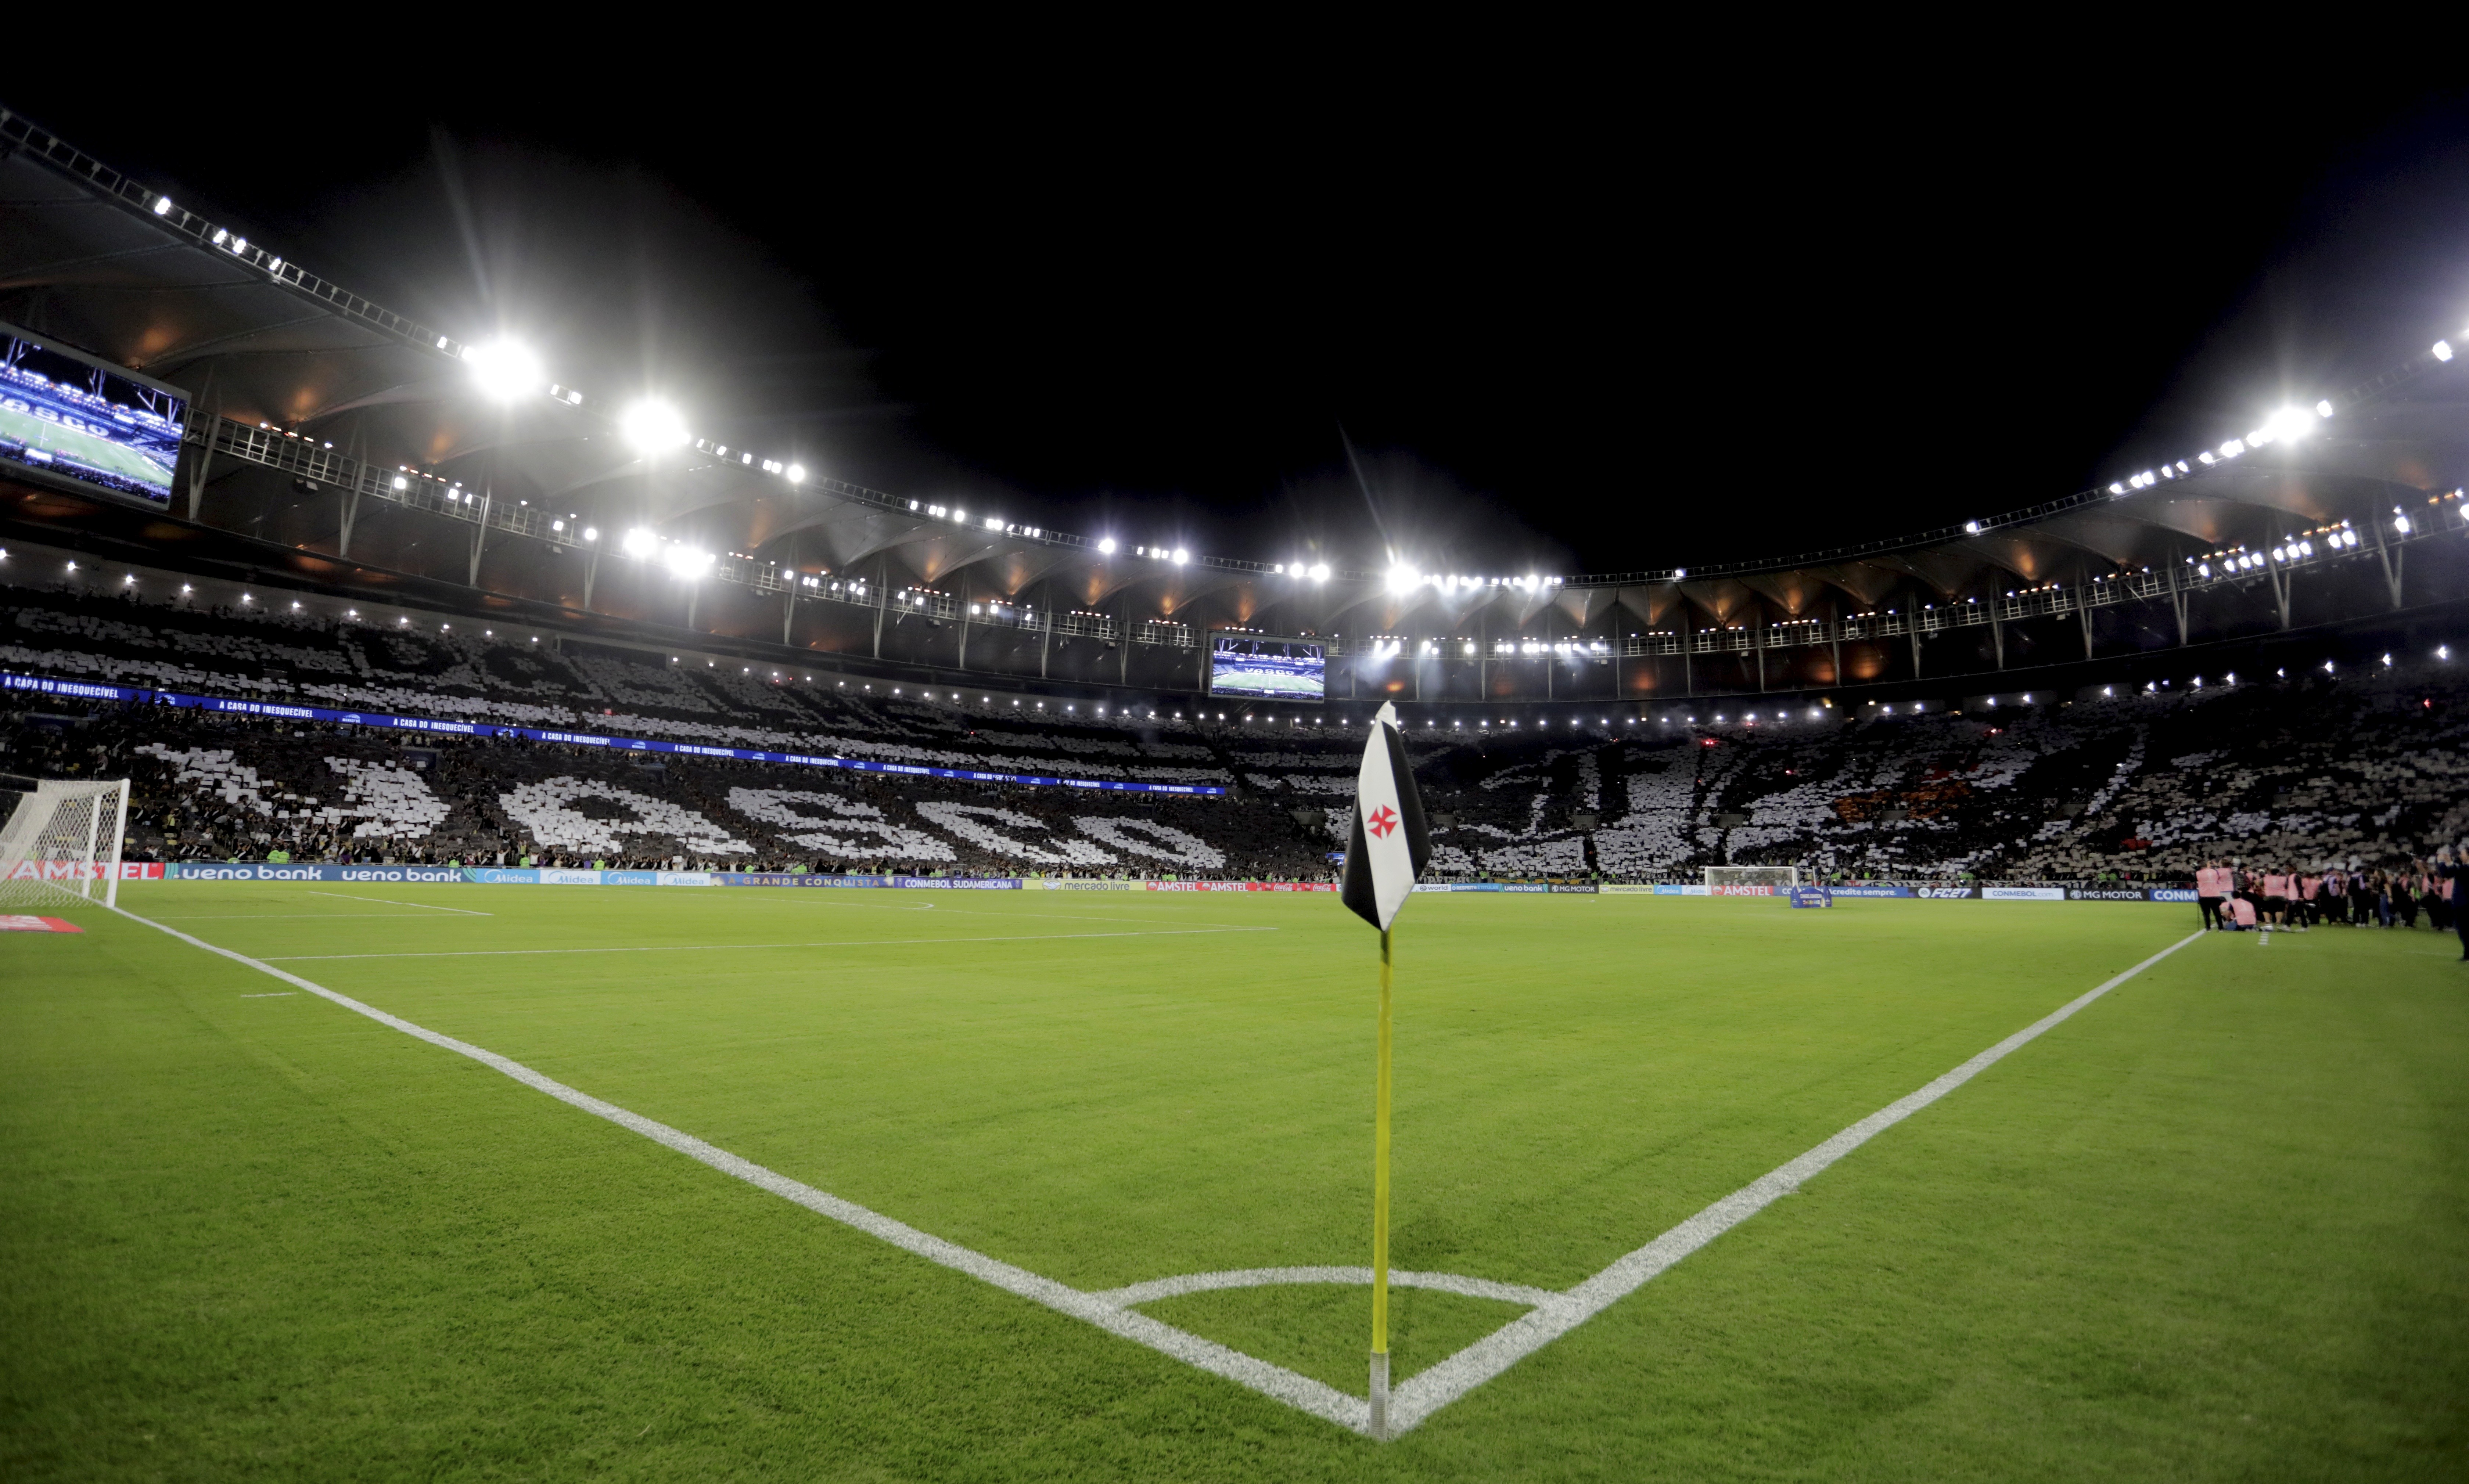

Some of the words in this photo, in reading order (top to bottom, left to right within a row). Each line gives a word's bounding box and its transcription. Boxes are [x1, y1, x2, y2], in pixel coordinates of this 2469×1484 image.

[0, 394, 109, 437] ASCO
[1245, 667, 1294, 676] VASCO
[6, 677, 11, 685] A
[42, 681, 53, 691] DO
[57, 683, 118, 698] INESQUECÍVEL
[227, 702, 247, 711] CASA
[250, 704, 260, 712] DO
[263, 705, 313, 717] INESQUECÍVEL
[400, 719, 417, 728] CASA
[419, 721, 428, 729] DO
[431, 721, 474, 733] INESQUECÍVEL
[702, 748, 734, 757] INESQUECÍVEL
[810, 757, 838, 766] INESQUECÍVEL
[183, 868, 252, 879] ueno
[258, 866, 322, 880] bank
[342, 871, 402, 881] ueno
[406, 868, 461, 882] bank
[495, 874, 533, 883] Midea
[618, 876, 650, 884] Midea
[743, 877, 798, 886] GRANDE
[805, 878, 879, 887] CONQUISTA
[905, 879, 951, 888] CONMEBOL
[953, 880, 1012, 889] SUDAMERICANA
[1111, 882, 1129, 890] livre
[1157, 882, 1198, 891] AMSTEL
[1210, 883, 1248, 891] AMSTEL
[1724, 886, 1770, 895] AMSTEL
[1931, 888, 1972, 898] FC27
[2154, 890, 2198, 900] CONM
